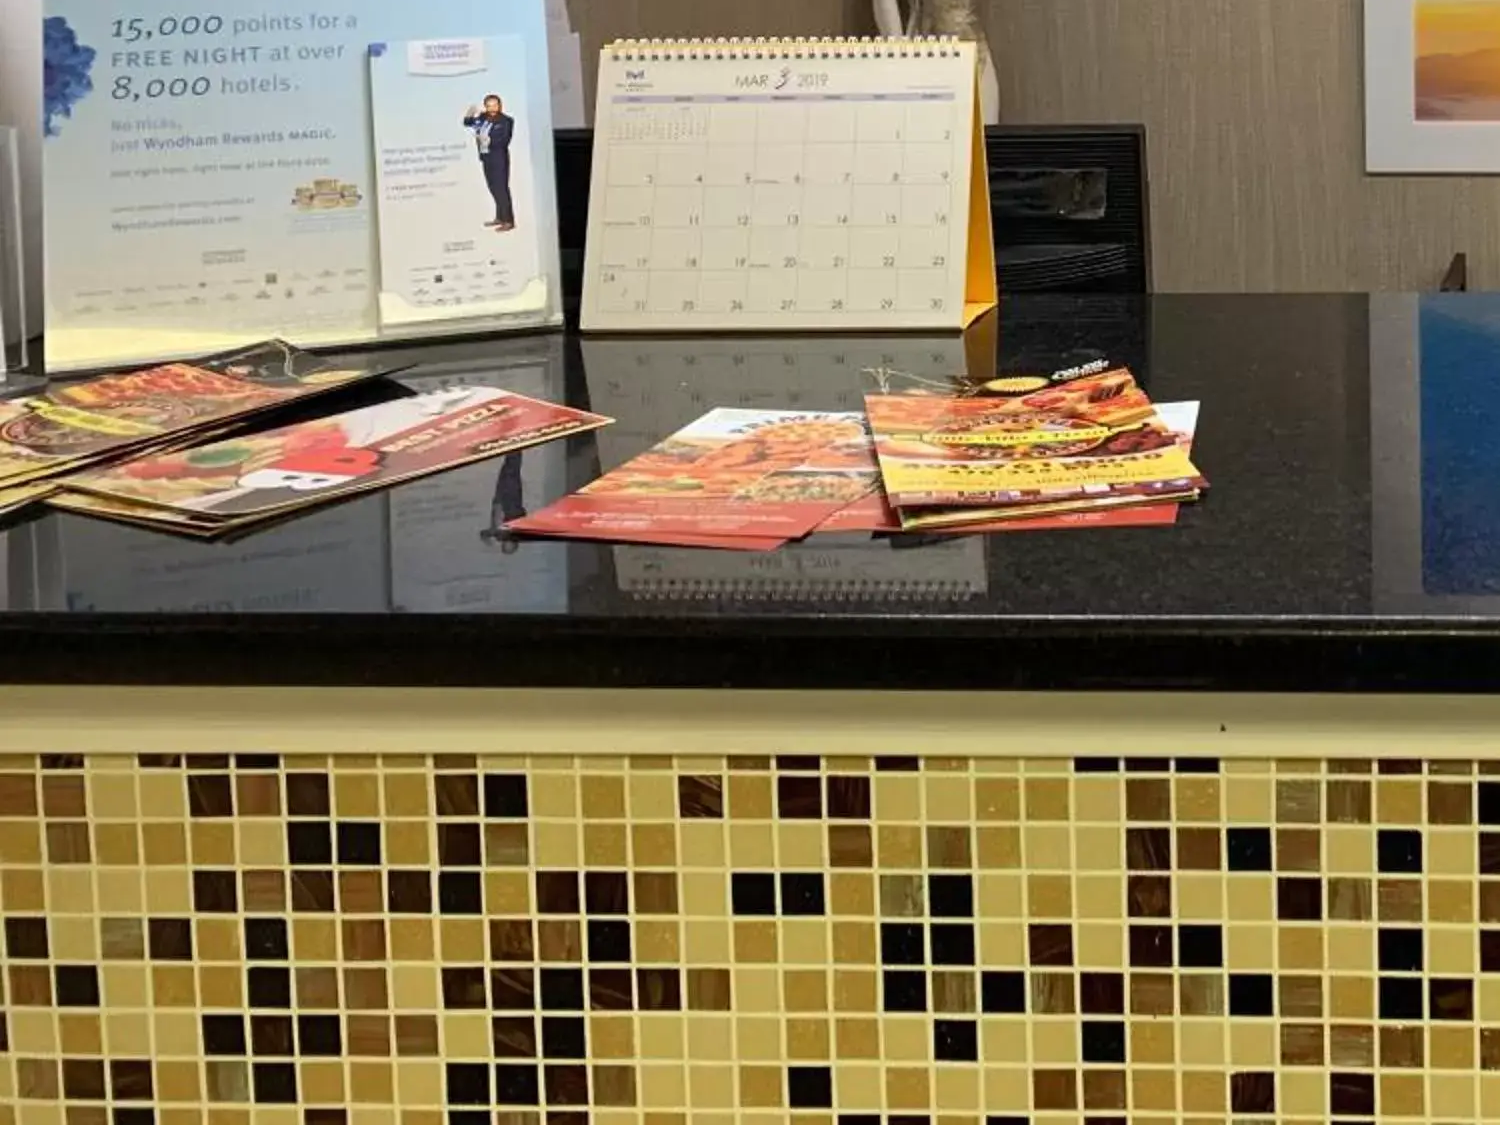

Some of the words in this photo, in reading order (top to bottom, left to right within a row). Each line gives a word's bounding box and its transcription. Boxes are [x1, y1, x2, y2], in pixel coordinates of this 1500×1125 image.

[111, 15, 223, 42] 15,000
[232, 14, 303, 36] points
[309, 13, 340, 30] for
[345, 16, 358, 30] a
[111, 50, 173, 69] FREE
[183, 46, 262, 67] NIGHT
[269, 46, 291, 62] at
[297, 45, 345, 61] over
[111, 75, 212, 102] 8,000
[220, 75, 301, 96] hotels.
[735, 74, 769, 89] MAR
[797, 74, 829, 87] 2019
[144, 133, 218, 155] Wyndham
[222, 131, 284, 145] Rewards
